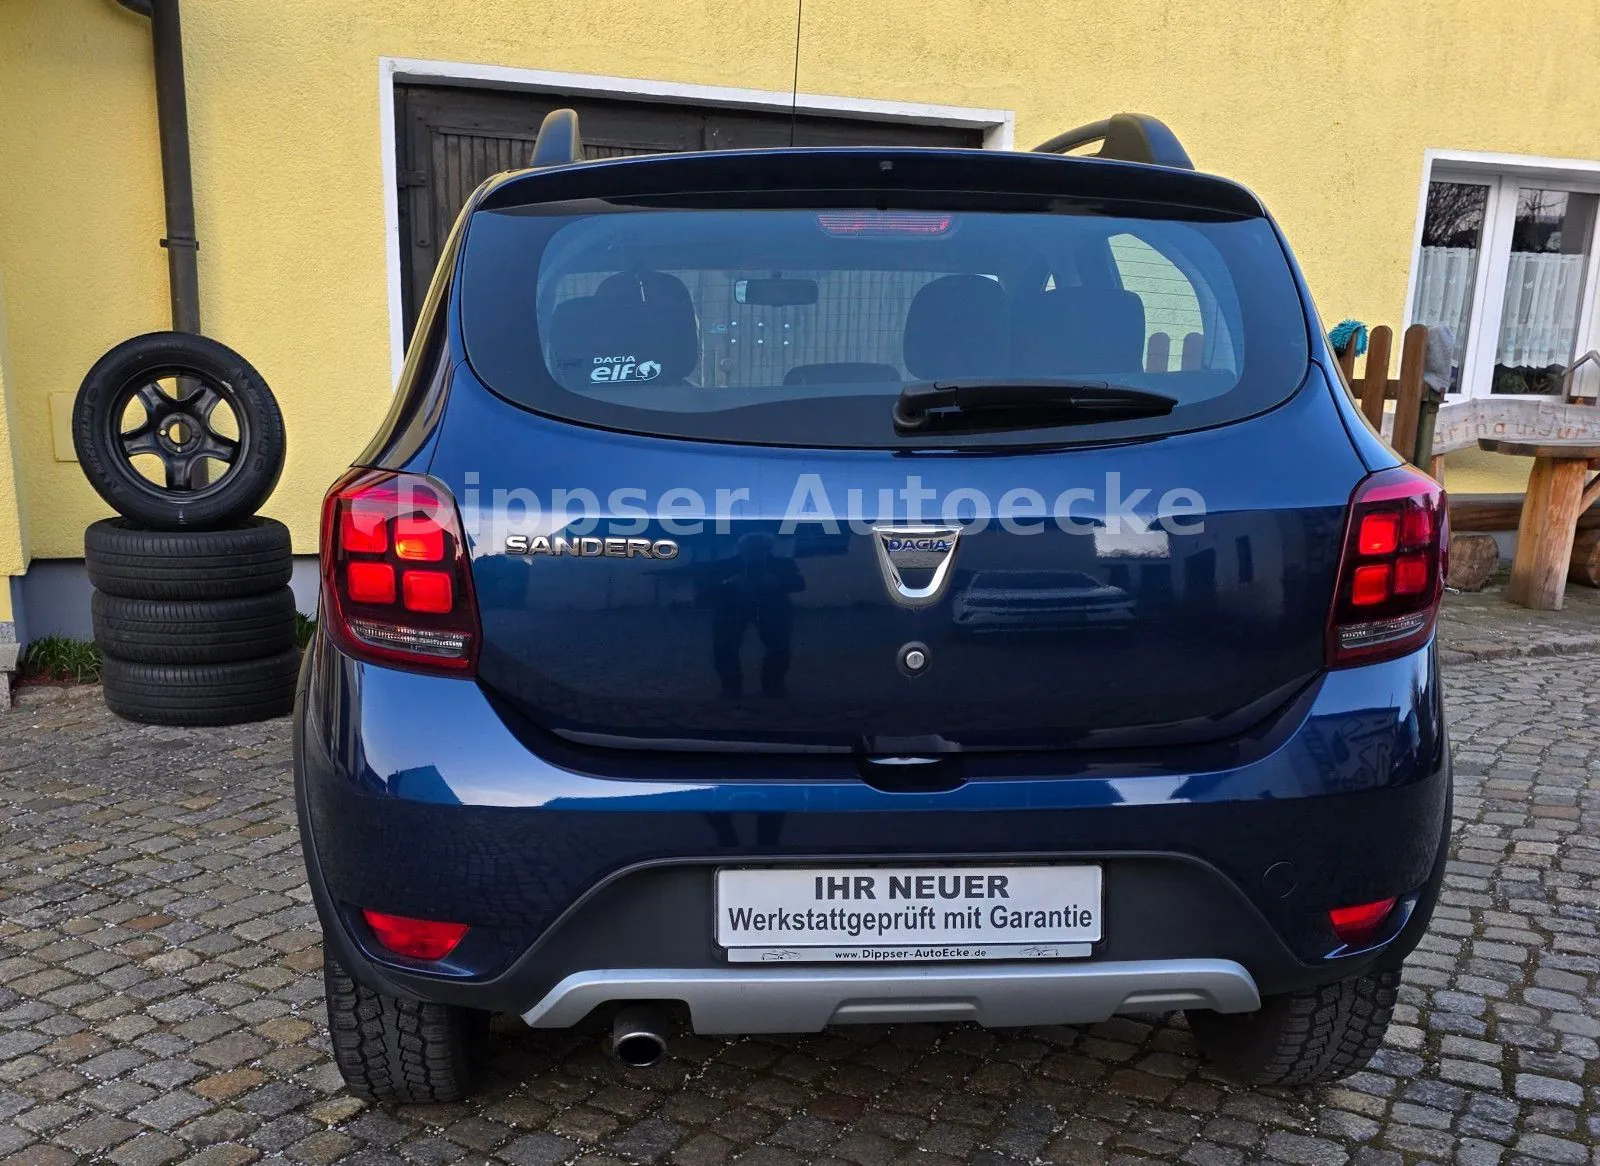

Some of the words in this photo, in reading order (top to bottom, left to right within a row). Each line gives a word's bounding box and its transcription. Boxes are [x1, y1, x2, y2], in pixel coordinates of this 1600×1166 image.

[593, 355, 636, 364] DACIA
[590, 363, 636, 381] elf
[505, 535, 679, 560] SANDERO
[888, 539, 948, 552] DACIA
[815, 876, 875, 900] IHR
[888, 875, 1009, 900] NEUER
[728, 906, 936, 936] Werkstattgeprüft
[943, 905, 982, 929] mit
[989, 903, 1093, 929] Garantie
[835, 948, 987, 959] www.Dippser-AutoEcke.de
